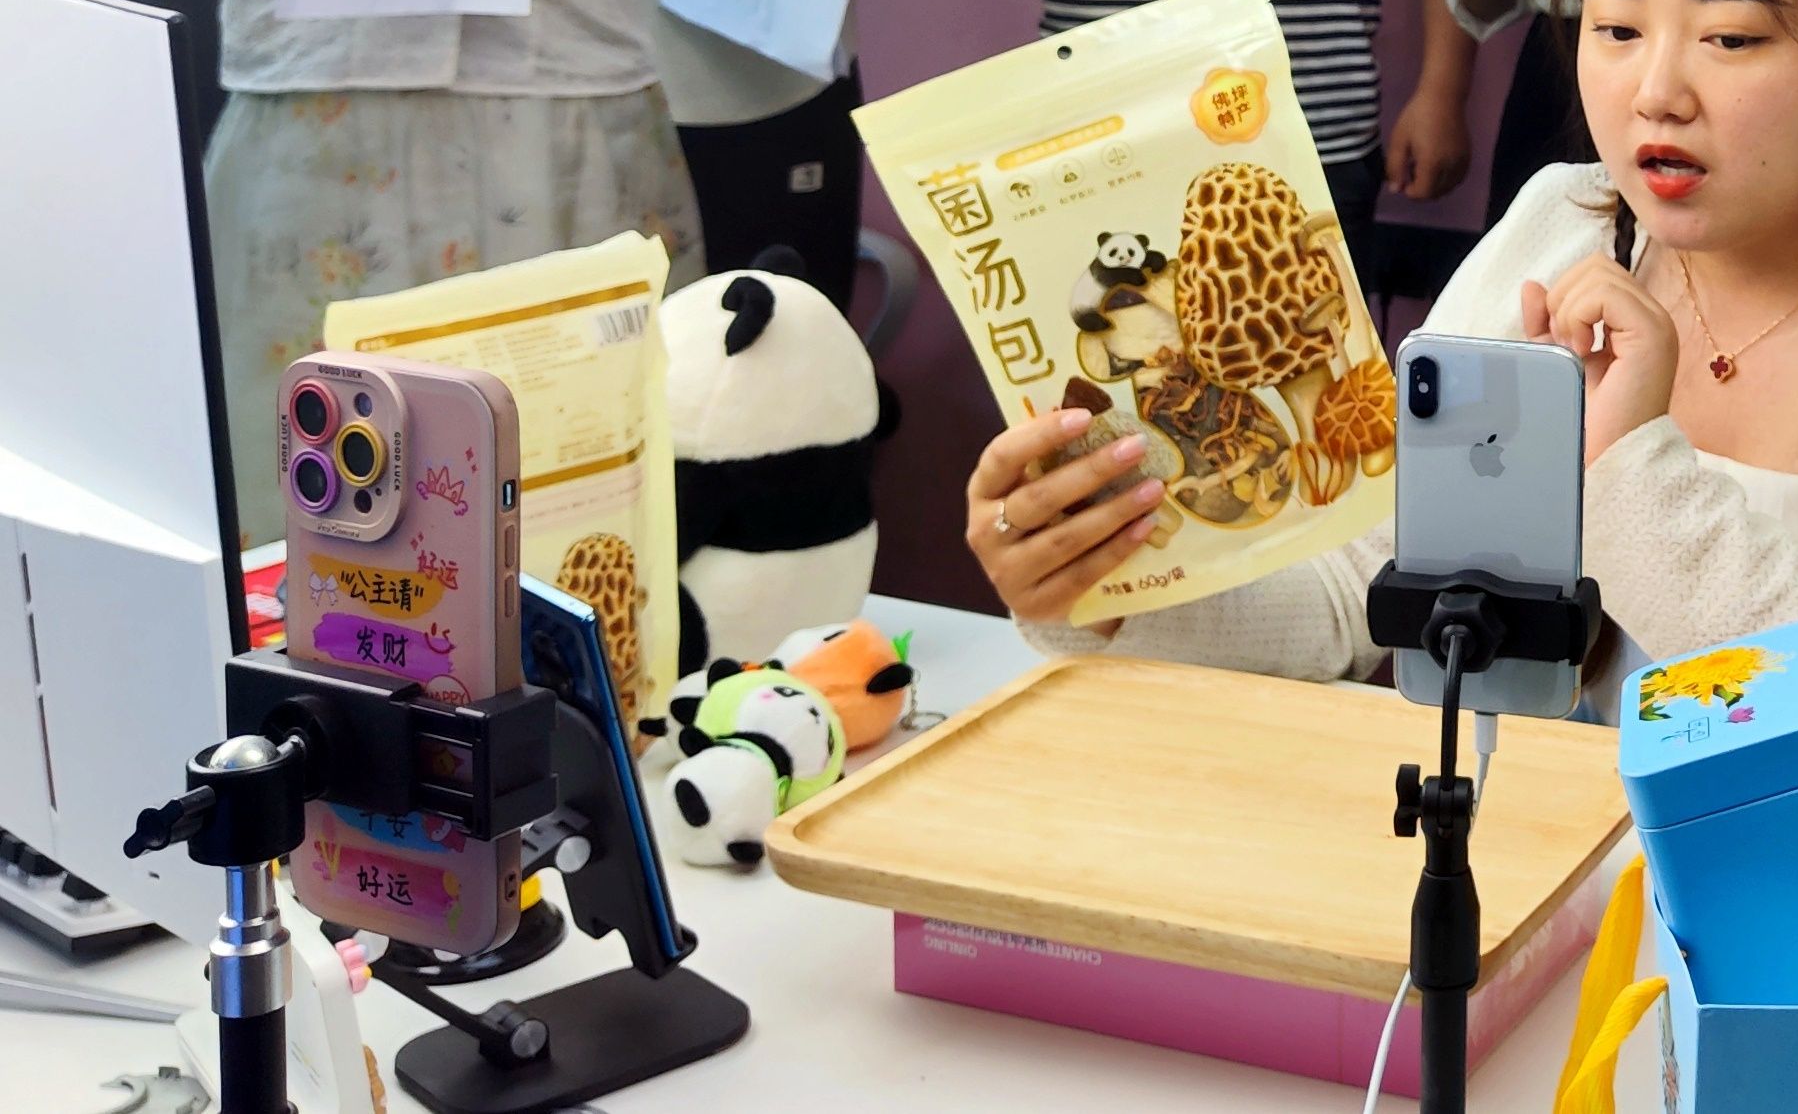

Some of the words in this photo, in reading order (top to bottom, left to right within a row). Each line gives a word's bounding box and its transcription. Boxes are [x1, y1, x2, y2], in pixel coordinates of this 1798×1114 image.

[917, 161, 1055, 385] 菌汤包
[417, 550, 459, 590] 好运
[357, 626, 408, 667] 发财
[357, 865, 413, 905] 好运
